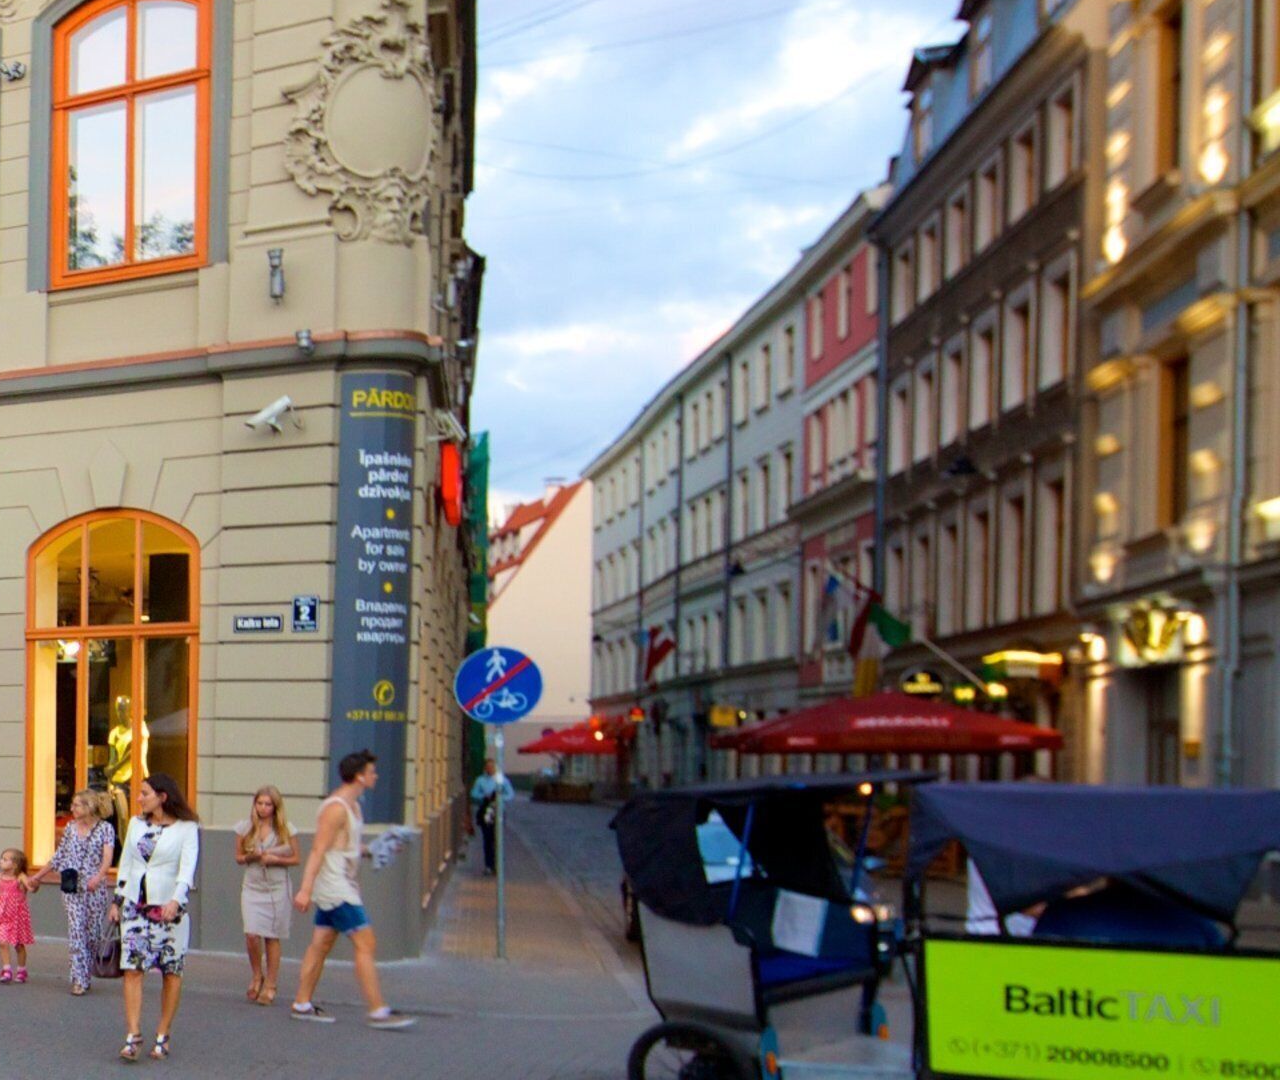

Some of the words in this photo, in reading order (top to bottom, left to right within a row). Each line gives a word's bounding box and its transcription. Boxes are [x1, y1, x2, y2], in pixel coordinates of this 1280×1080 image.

[352, 386, 417, 411] PĀRDO
[365, 541, 384, 555] for
[358, 557, 376, 575] by
[299, 605, 310, 621] 2
[1046, 1044, 1169, 1072] 20008500
